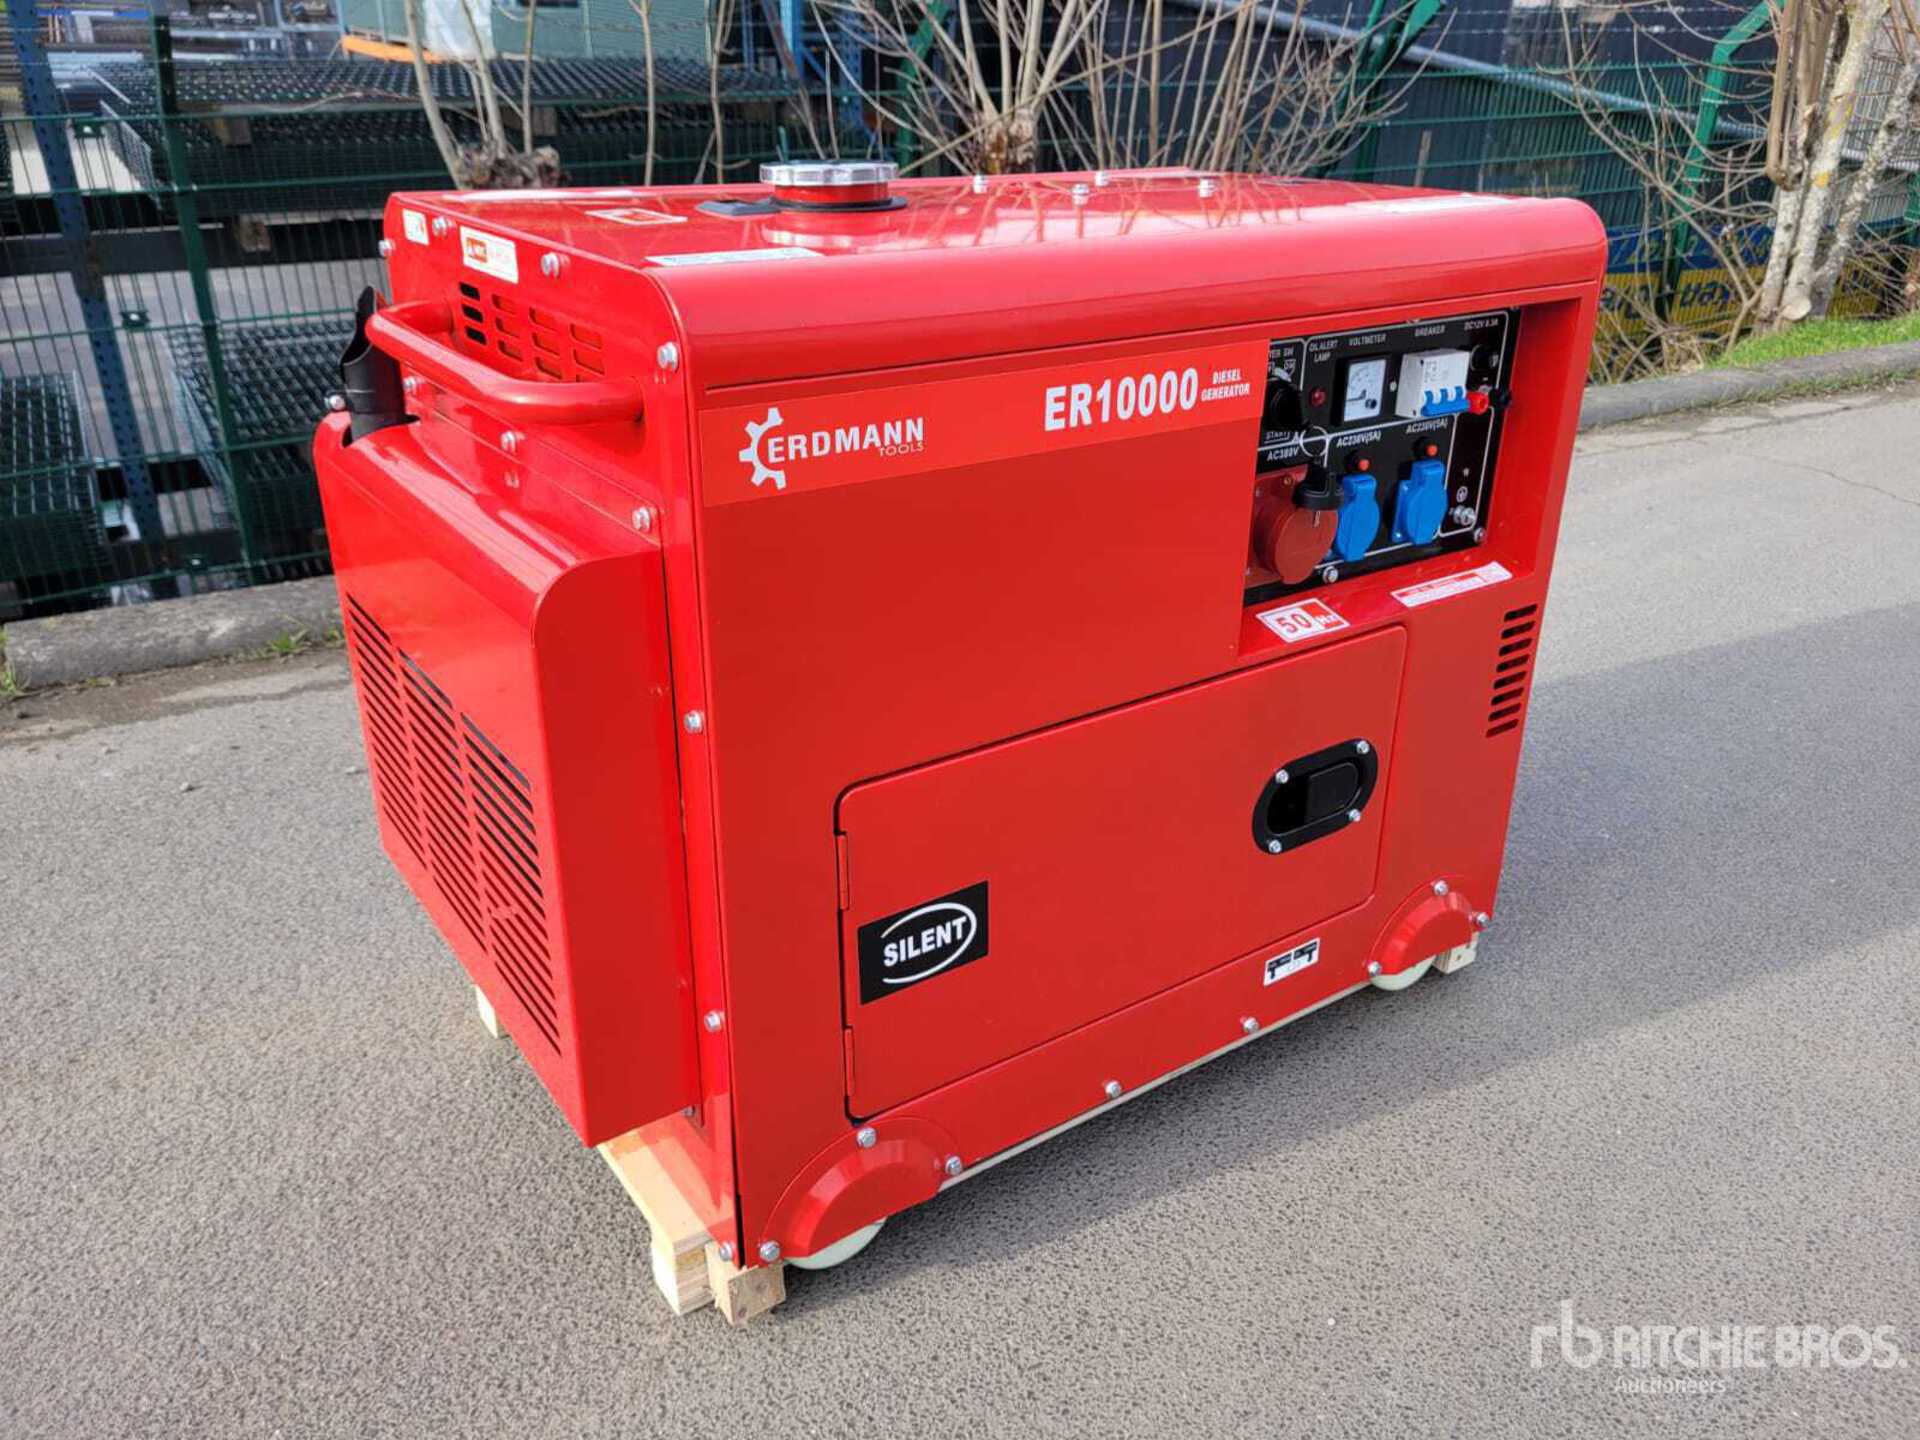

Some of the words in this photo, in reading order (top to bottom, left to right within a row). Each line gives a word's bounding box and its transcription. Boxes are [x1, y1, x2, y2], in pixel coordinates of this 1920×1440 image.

[1348, 333, 1387, 347] VOLTMETER
[1314, 351, 1331, 362] LAMP
[1212, 368, 1242, 385] DIESEL
[1044, 367, 1198, 431] ER10000
[1201, 382, 1250, 402] GENERATOR
[767, 417, 924, 463] ERDMANN
[879, 441, 925, 458] TOOLS
[1275, 612, 1313, 634] 50
[883, 915, 967, 967] SILENT
